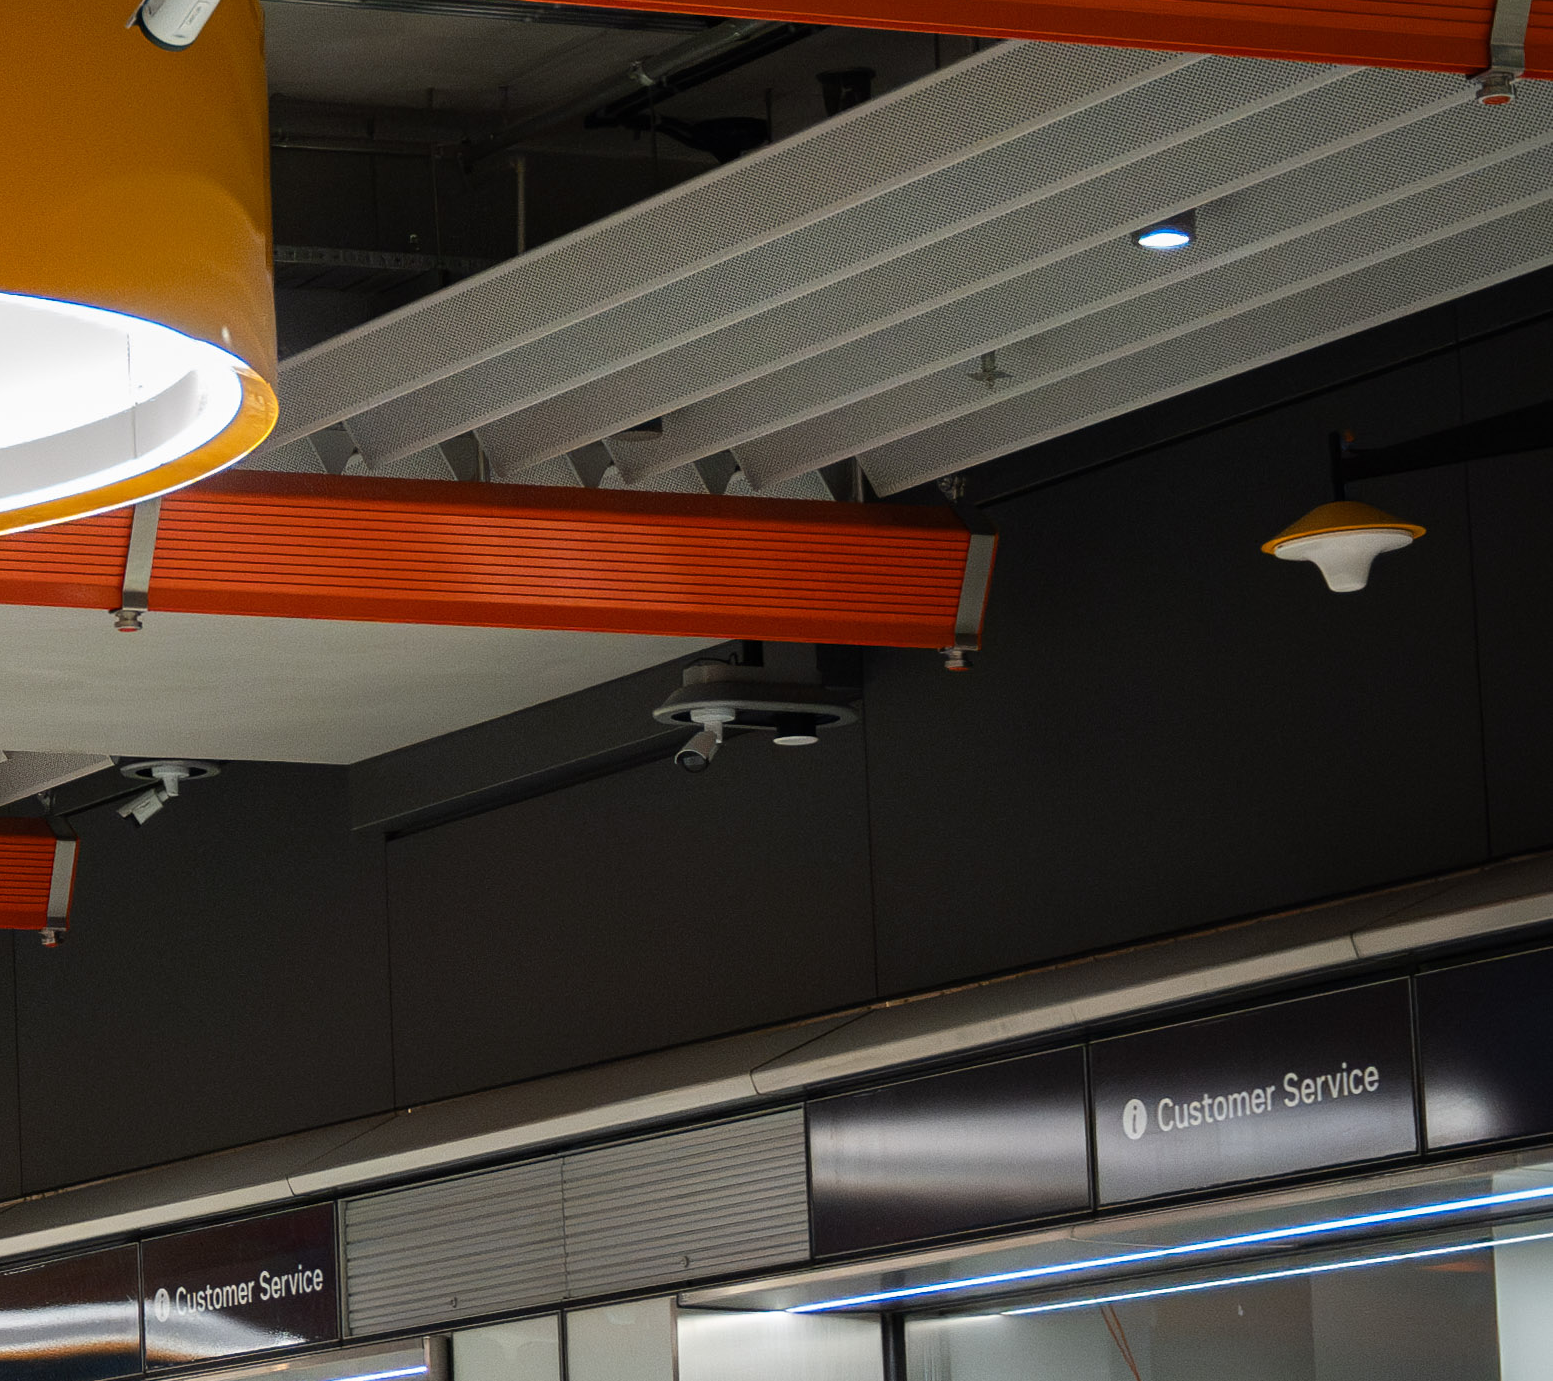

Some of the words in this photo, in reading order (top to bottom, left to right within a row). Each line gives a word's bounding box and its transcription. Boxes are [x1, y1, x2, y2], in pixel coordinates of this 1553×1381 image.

[1157, 1085, 1276, 1132] Customer
[1283, 1062, 1380, 1107] Service
[176, 1280, 255, 1316] Customer
[259, 1264, 324, 1301] Service
